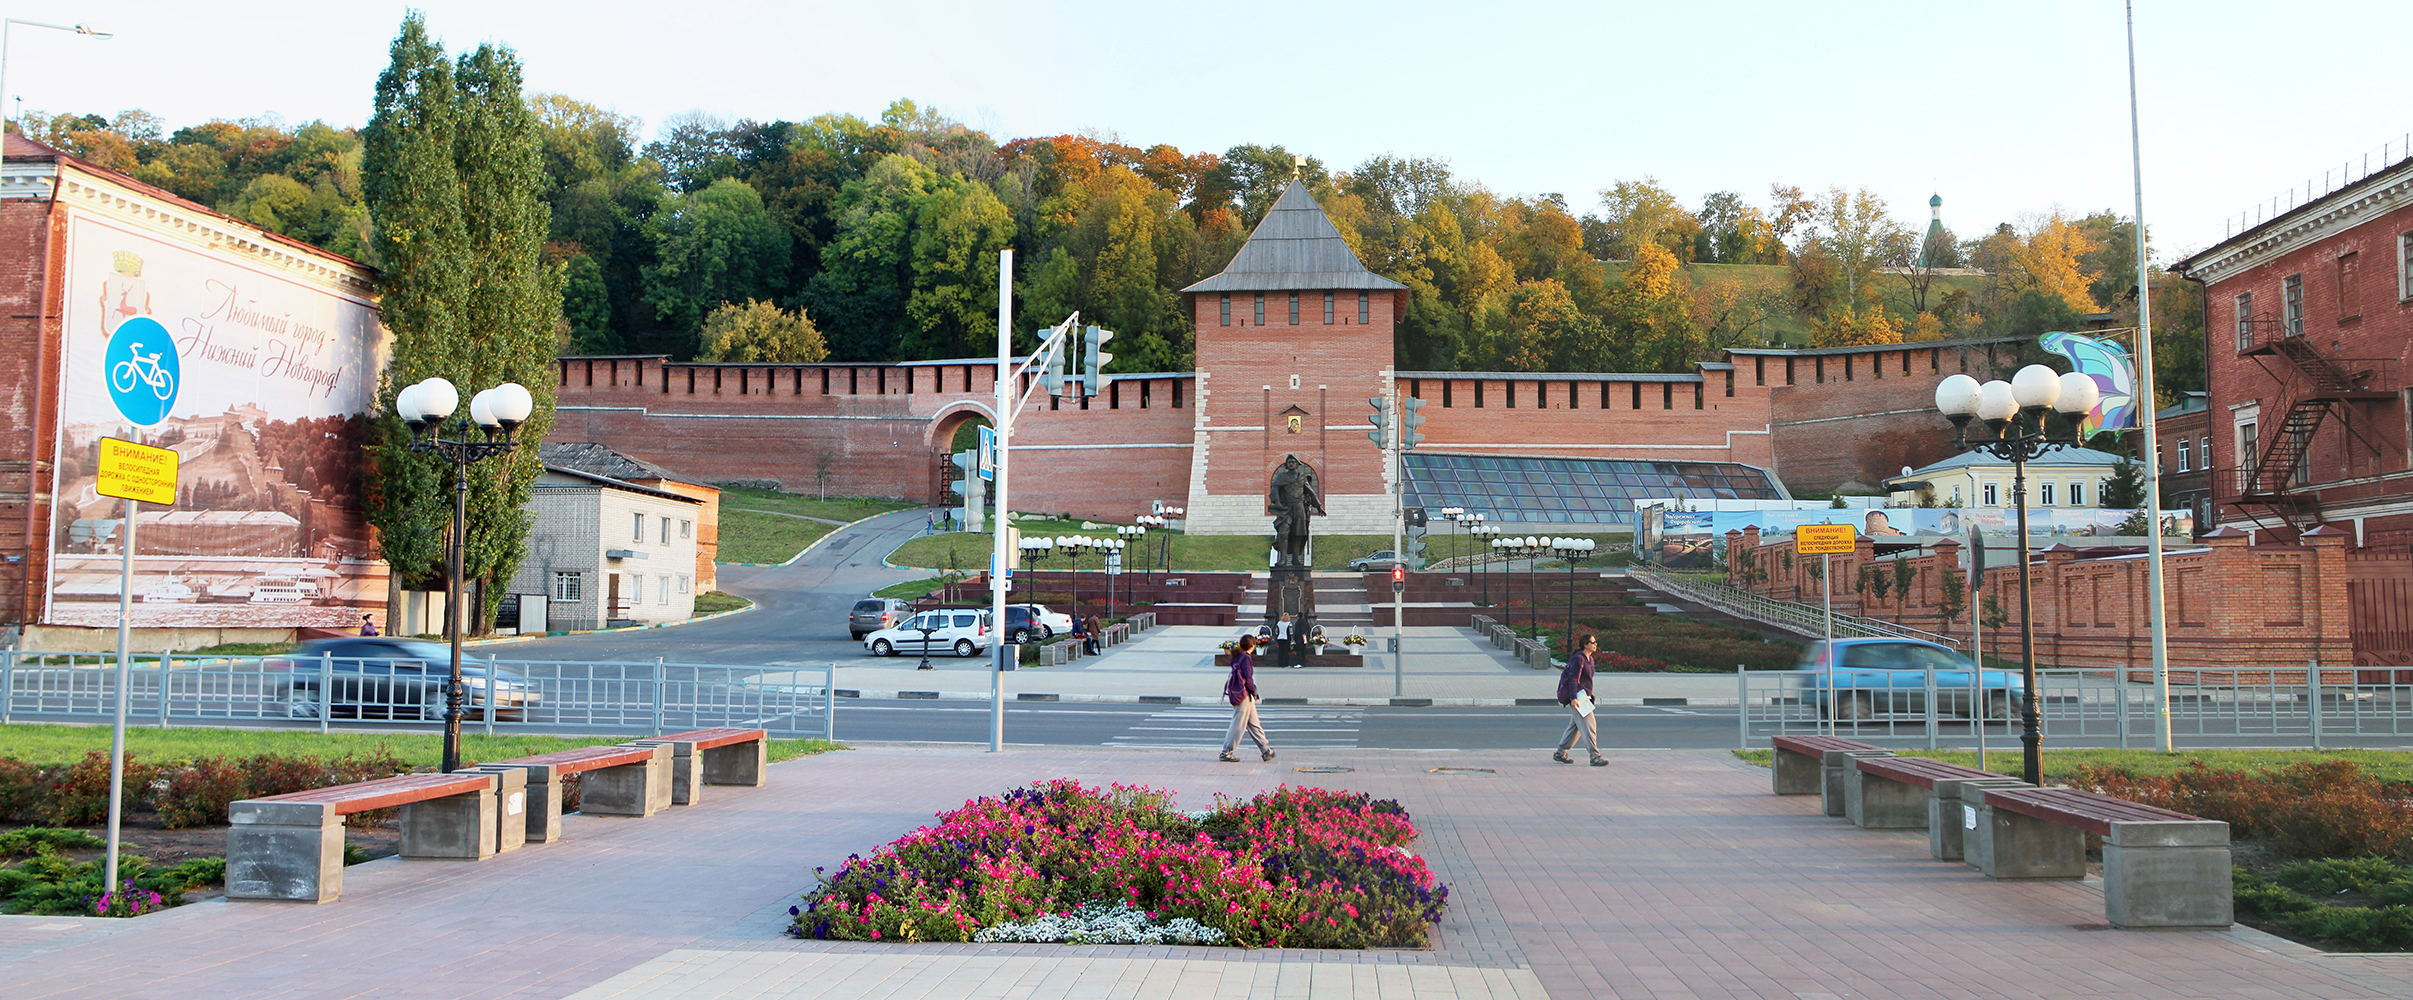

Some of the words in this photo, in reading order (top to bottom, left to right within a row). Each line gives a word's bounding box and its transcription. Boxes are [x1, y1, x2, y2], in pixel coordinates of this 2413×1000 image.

[200, 278, 291, 335] Любимый
[293, 323, 326, 356] город
[177, 317, 259, 369] Нижний
[261, 338, 342, 398] Новгород!
[113, 445, 167, 465] ВНИМАНИЕ!
[118, 462, 160, 476] ВЕЛОСИПЕДНАЯ
[100, 470, 125, 481] ДОРОЖКА
[126, 474, 131, 482] С
[132, 475, 175, 489] ОДНОСТОРОННИМ
[121, 484, 154, 496] ДВИЖЕНИЕМ
